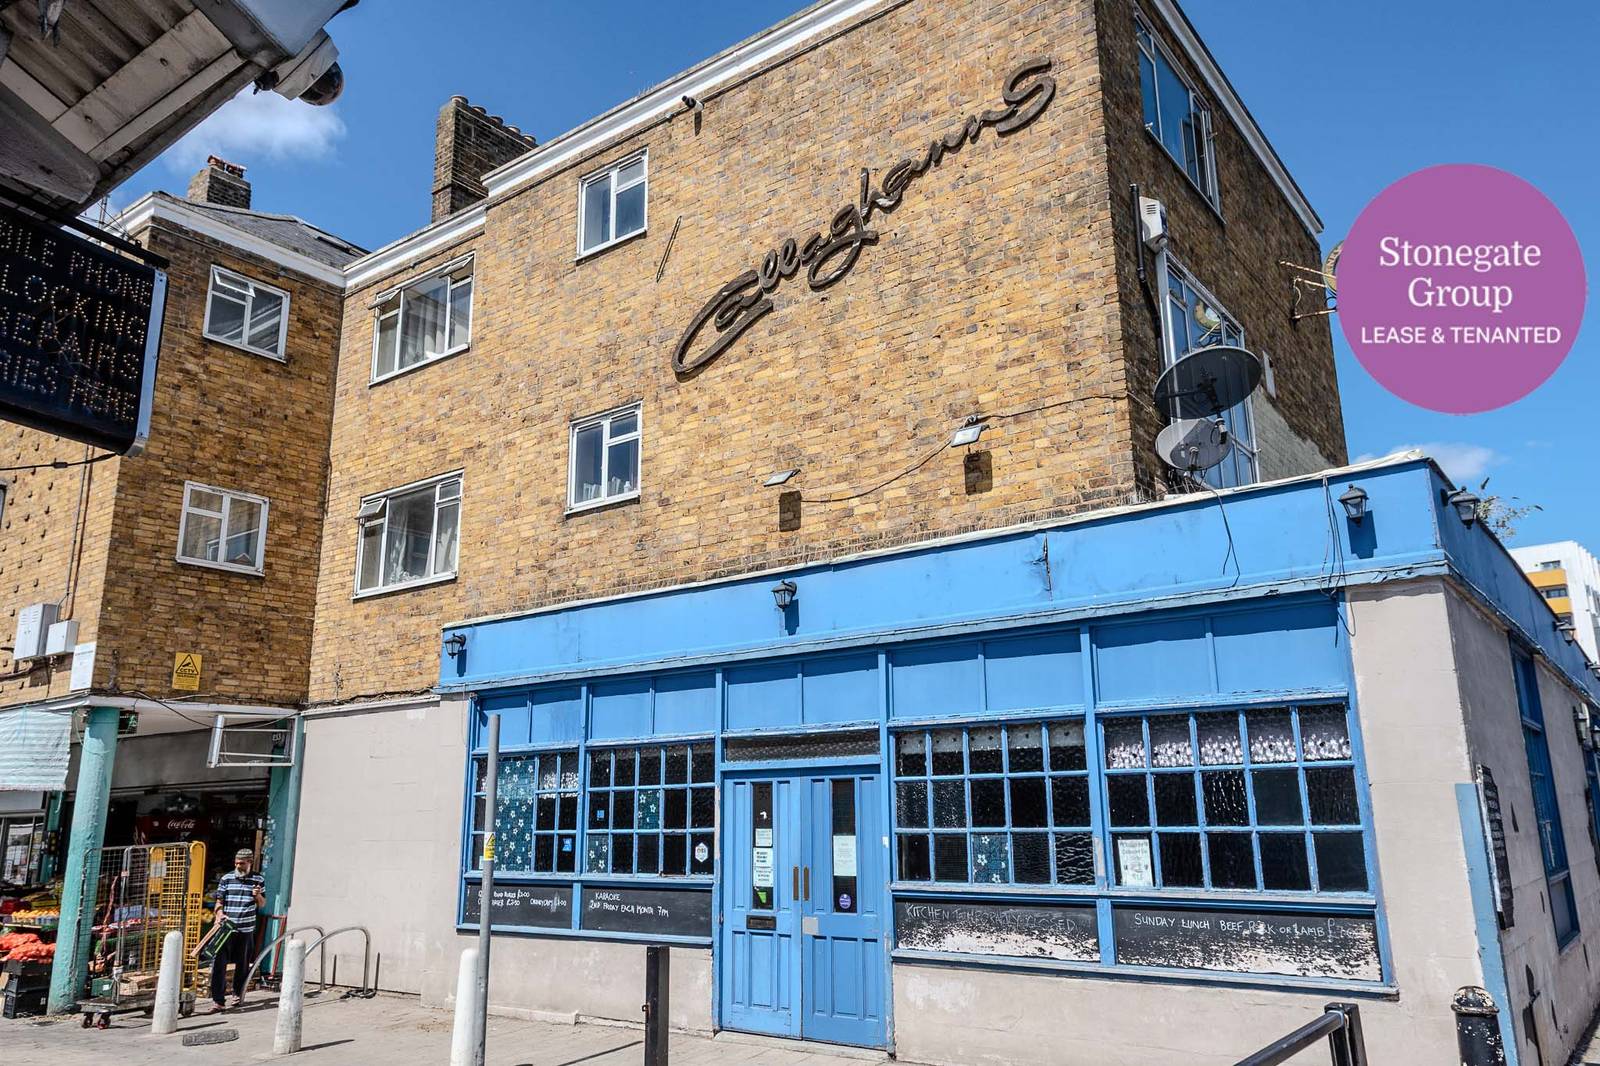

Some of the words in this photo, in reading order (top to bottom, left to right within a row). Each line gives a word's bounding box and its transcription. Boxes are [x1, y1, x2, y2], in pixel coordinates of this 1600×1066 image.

[69, 250, 152, 308] PHONE
[595, 892, 621, 901] KARAOKE
[603, 902, 619, 911] FRIDAY
[620, 904, 635, 914] EACH
[636, 905, 654, 915] MONTH
[905, 903, 950, 921] KITCHEN
[1134, 913, 1175, 927] SUNDAY
[1181, 918, 1210, 930] LUNCH
[1219, 920, 1244, 932] BEEF
[1279, 926, 1292, 934] OR
[1293, 922, 1325, 937] LAMB
